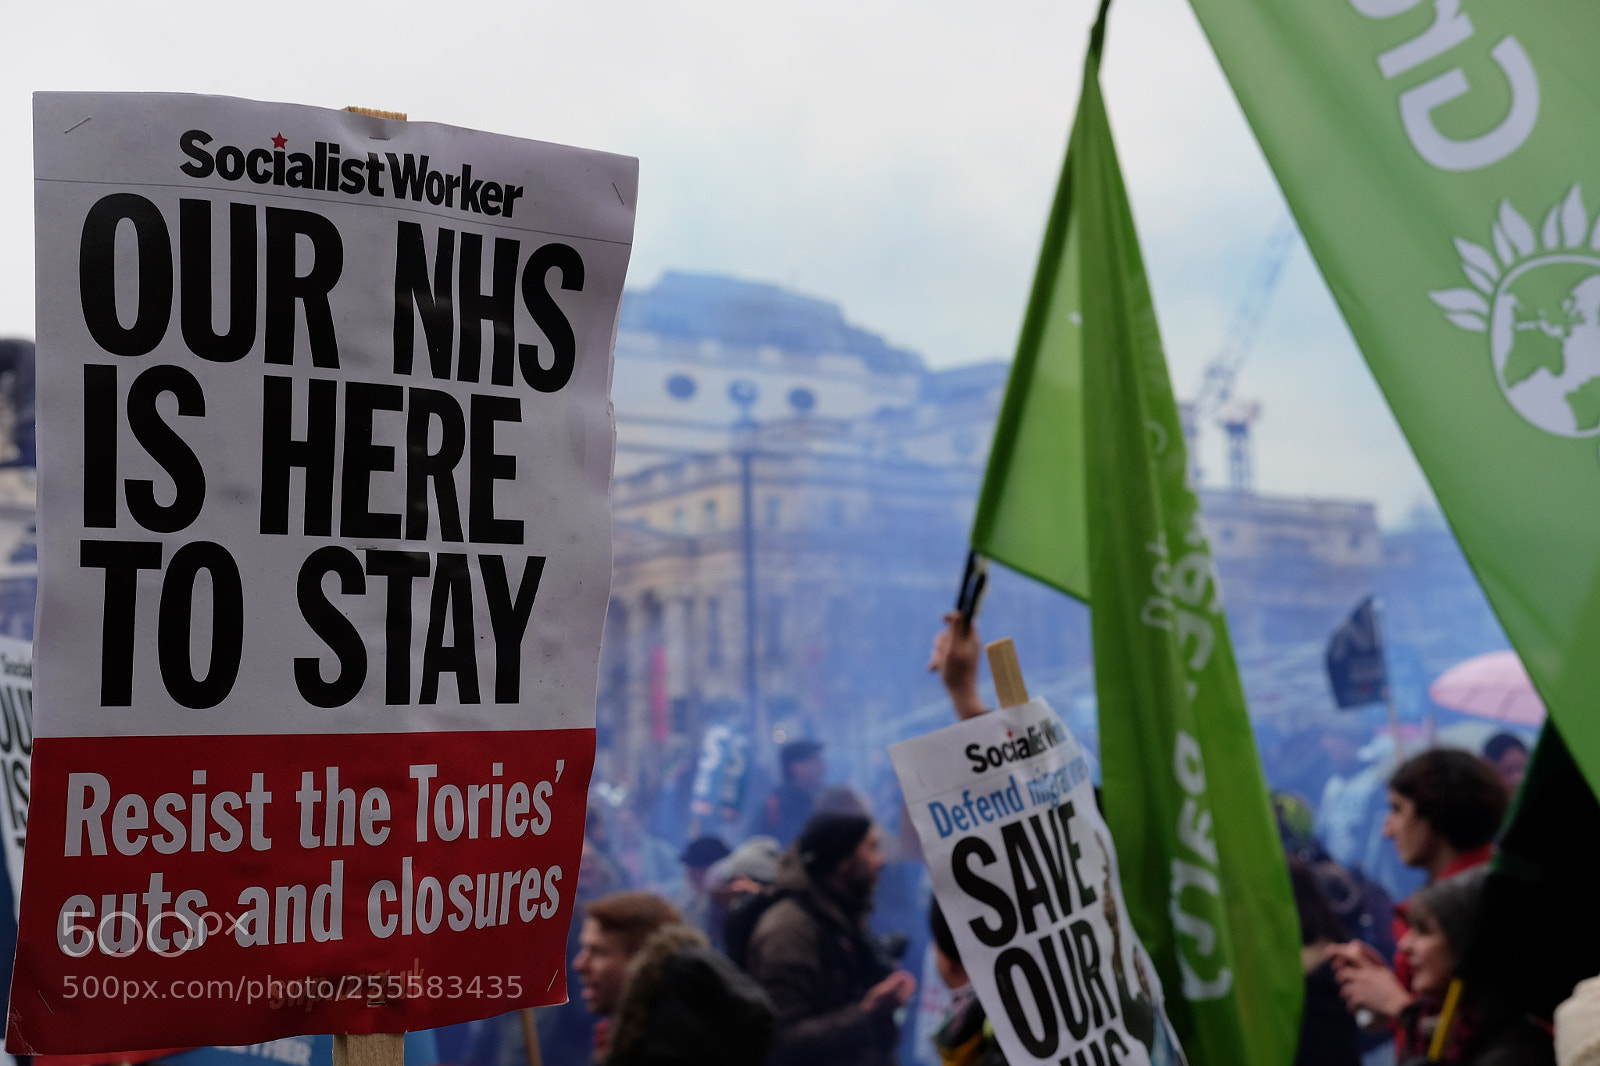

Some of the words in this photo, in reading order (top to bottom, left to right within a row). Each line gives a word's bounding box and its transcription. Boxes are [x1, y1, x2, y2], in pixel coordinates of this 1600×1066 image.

[179, 129, 385, 198] Socialist
[385, 152, 524, 219] Worker
[79, 192, 344, 370] OUR
[393, 220, 586, 393] NHS
[83, 363, 207, 534] IS
[259, 375, 525, 545] HERE
[80, 540, 244, 710] TO
[293, 545, 547, 709] STAY
[64, 769, 272, 858] Resist
[296, 766, 391, 850] the
[409, 759, 566, 844] Tories'
[928, 774, 1024, 840] Defend
[951, 801, 1098, 948] SAVE
[56, 872, 209, 957] cuts
[235, 859, 344, 948] and
[367, 856, 563, 936] closures
[994, 918, 1118, 1060] OUR
